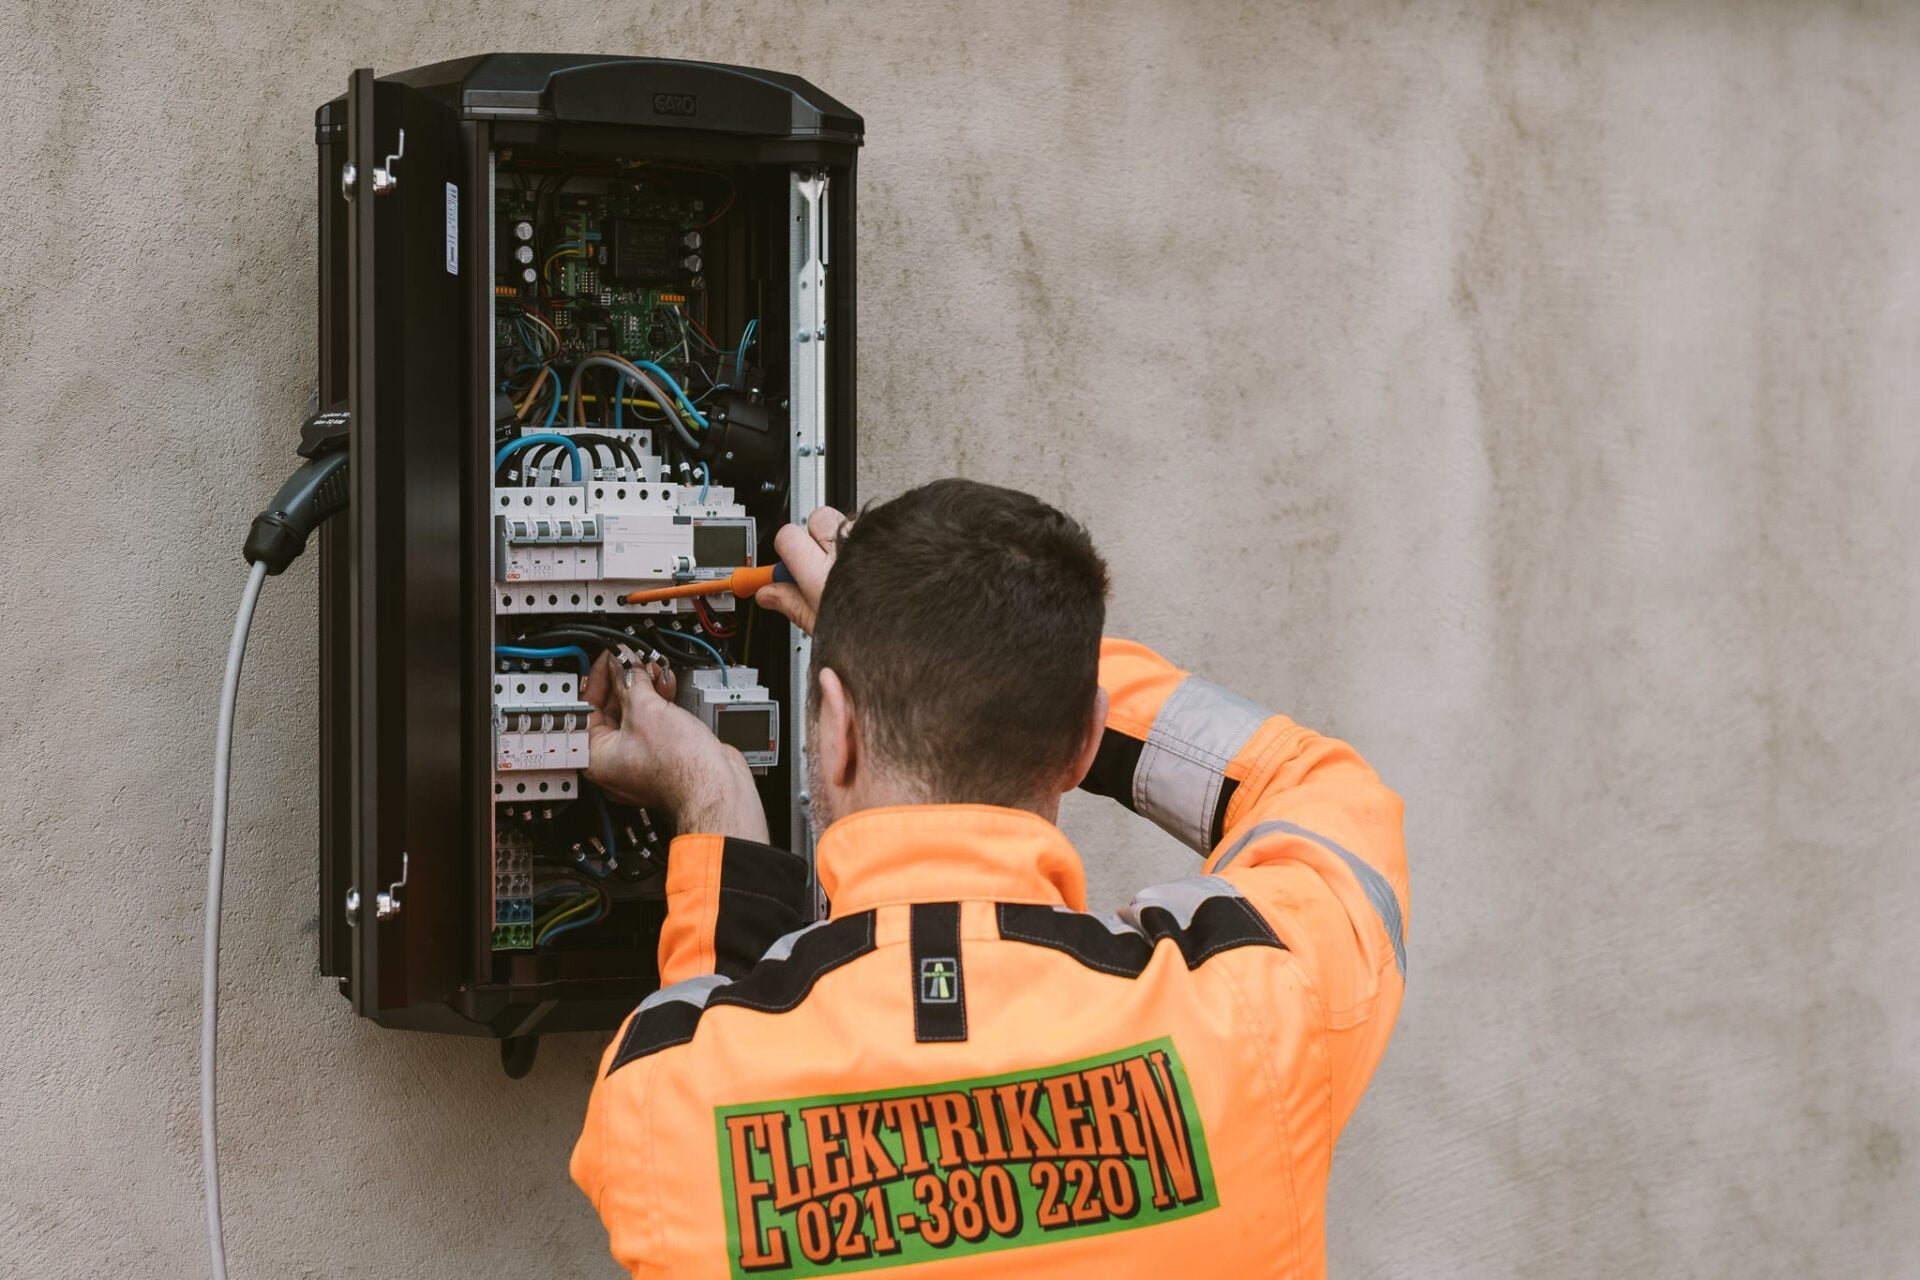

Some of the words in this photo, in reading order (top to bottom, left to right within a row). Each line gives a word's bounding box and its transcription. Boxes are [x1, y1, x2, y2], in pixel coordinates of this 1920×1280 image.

[654, 94, 694, 113] GARO
[797, 1165, 1021, 1263] 021-380
[1030, 1158, 1140, 1231] 220
